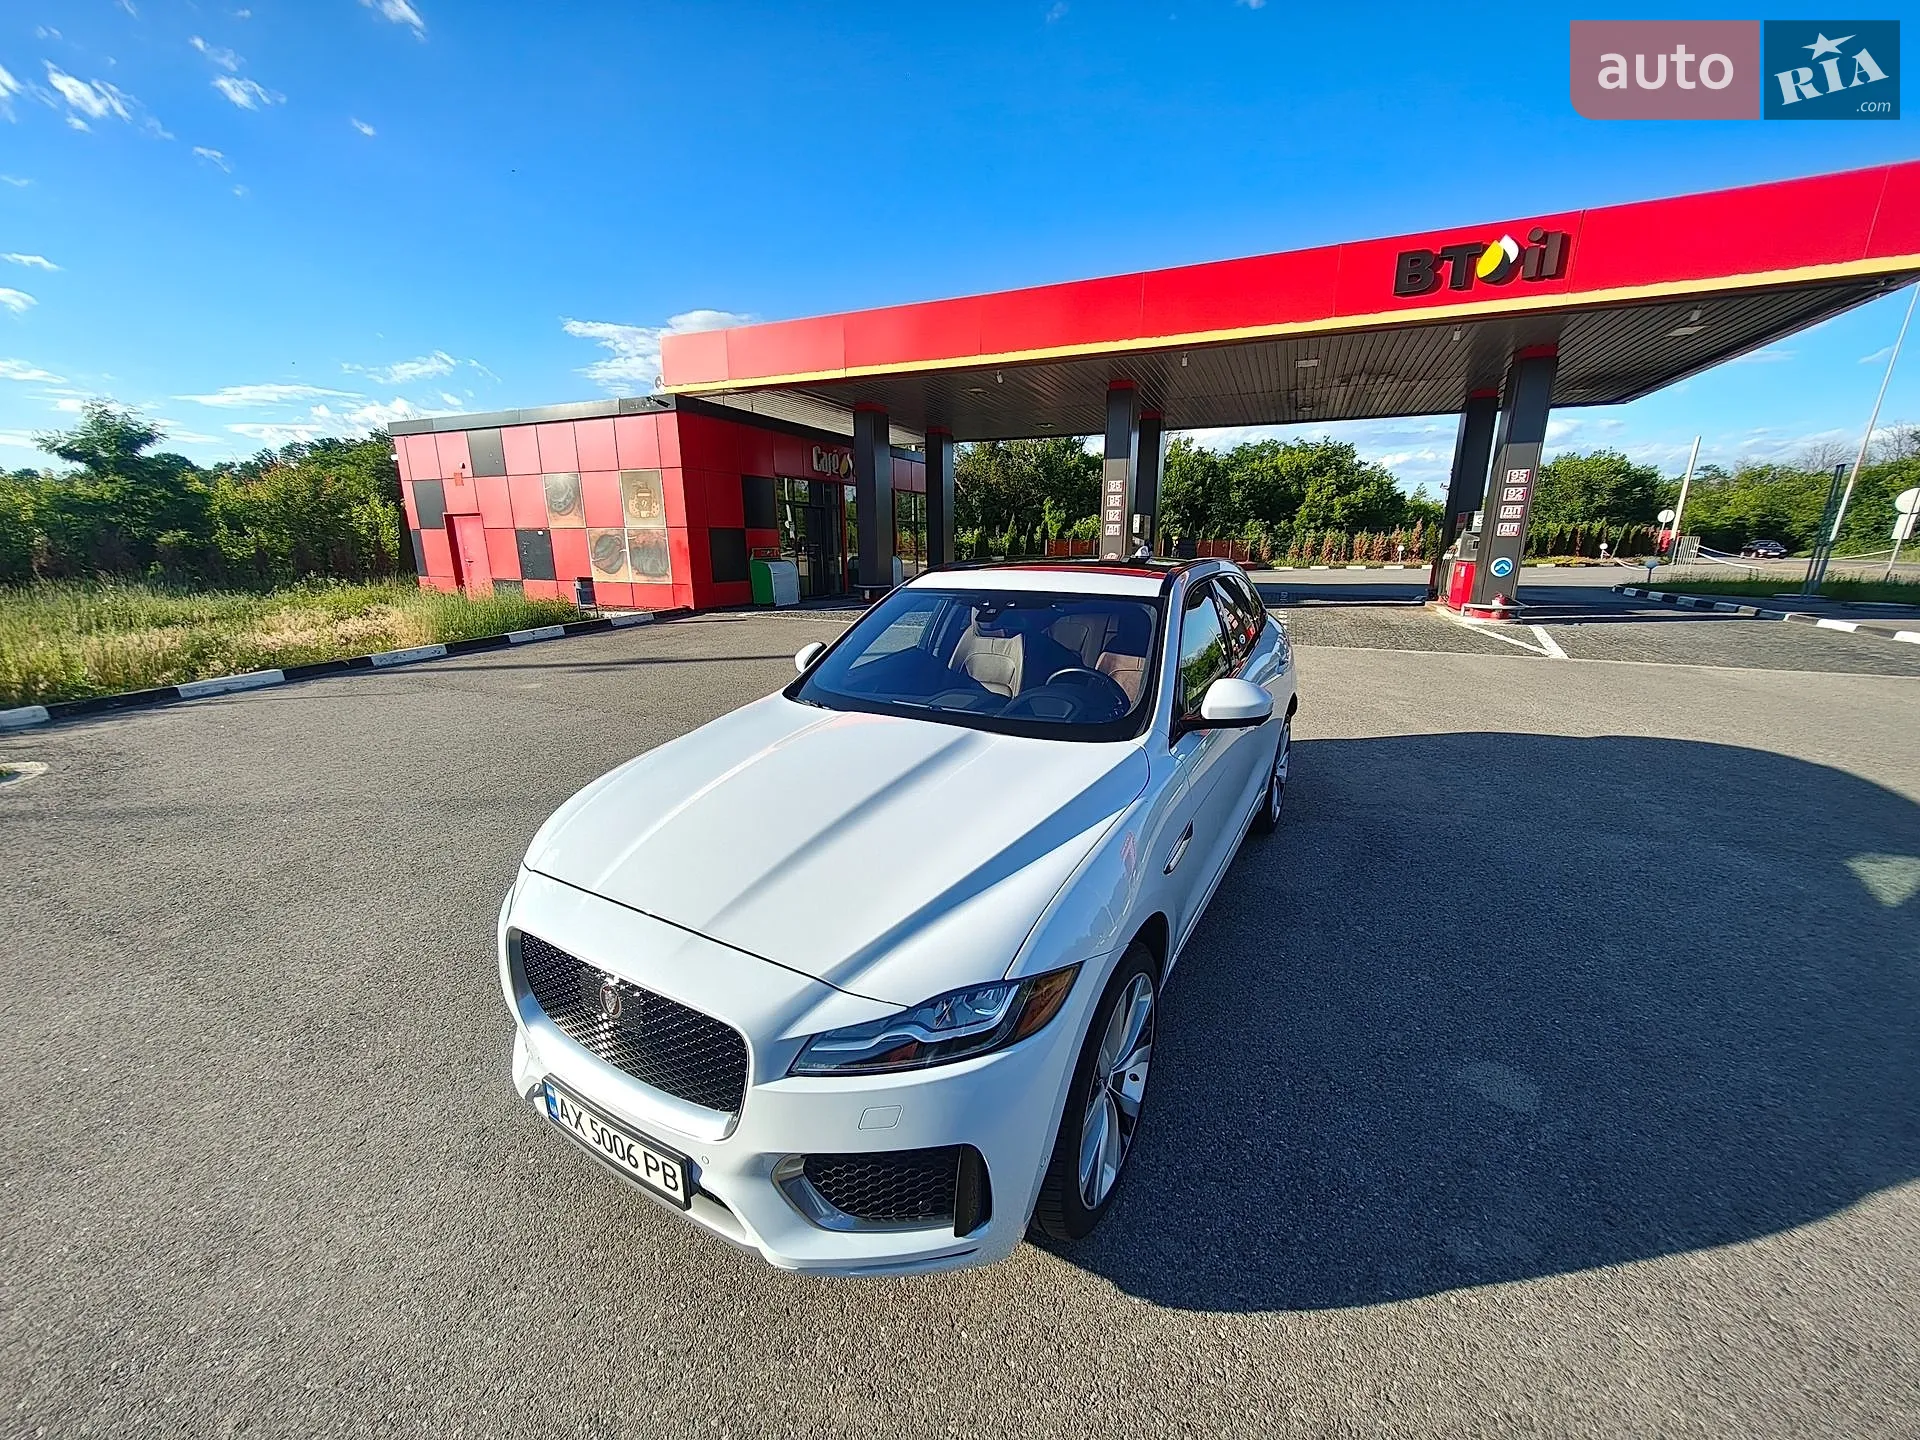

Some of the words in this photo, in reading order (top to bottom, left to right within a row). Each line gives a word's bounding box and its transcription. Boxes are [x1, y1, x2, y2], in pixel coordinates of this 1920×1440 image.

[560, 1098, 588, 1137] AX
[589, 1117, 639, 1170] 5006
[643, 1150, 679, 1192] PB
